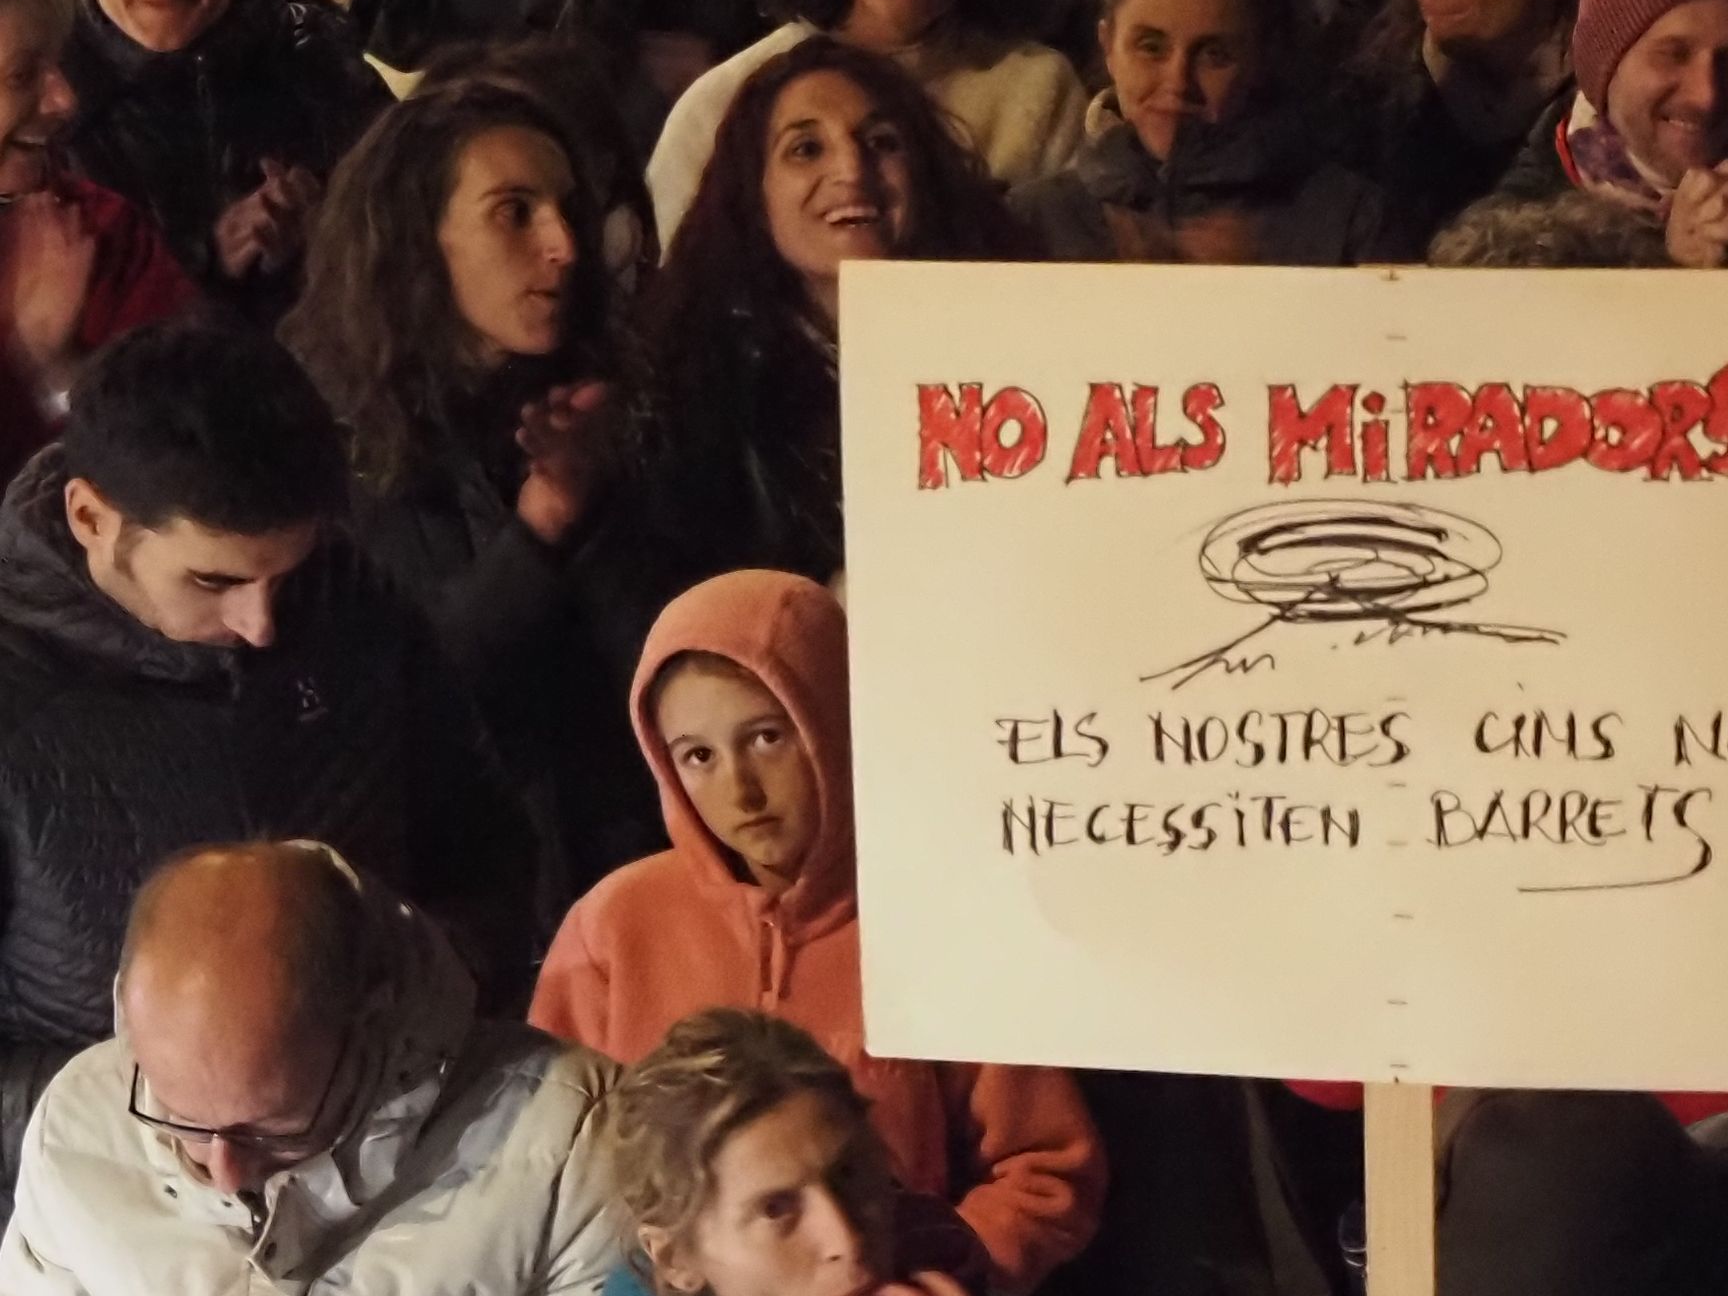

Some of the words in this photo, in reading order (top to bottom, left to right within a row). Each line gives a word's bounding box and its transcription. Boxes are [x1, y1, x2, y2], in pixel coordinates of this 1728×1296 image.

[915, 381, 1048, 490] NO
[1064, 381, 1228, 486] ALS
[994, 706, 1111, 768] ELS
[1150, 705, 1414, 769] NOSTRES
[1426, 784, 1714, 893] BARRETS
